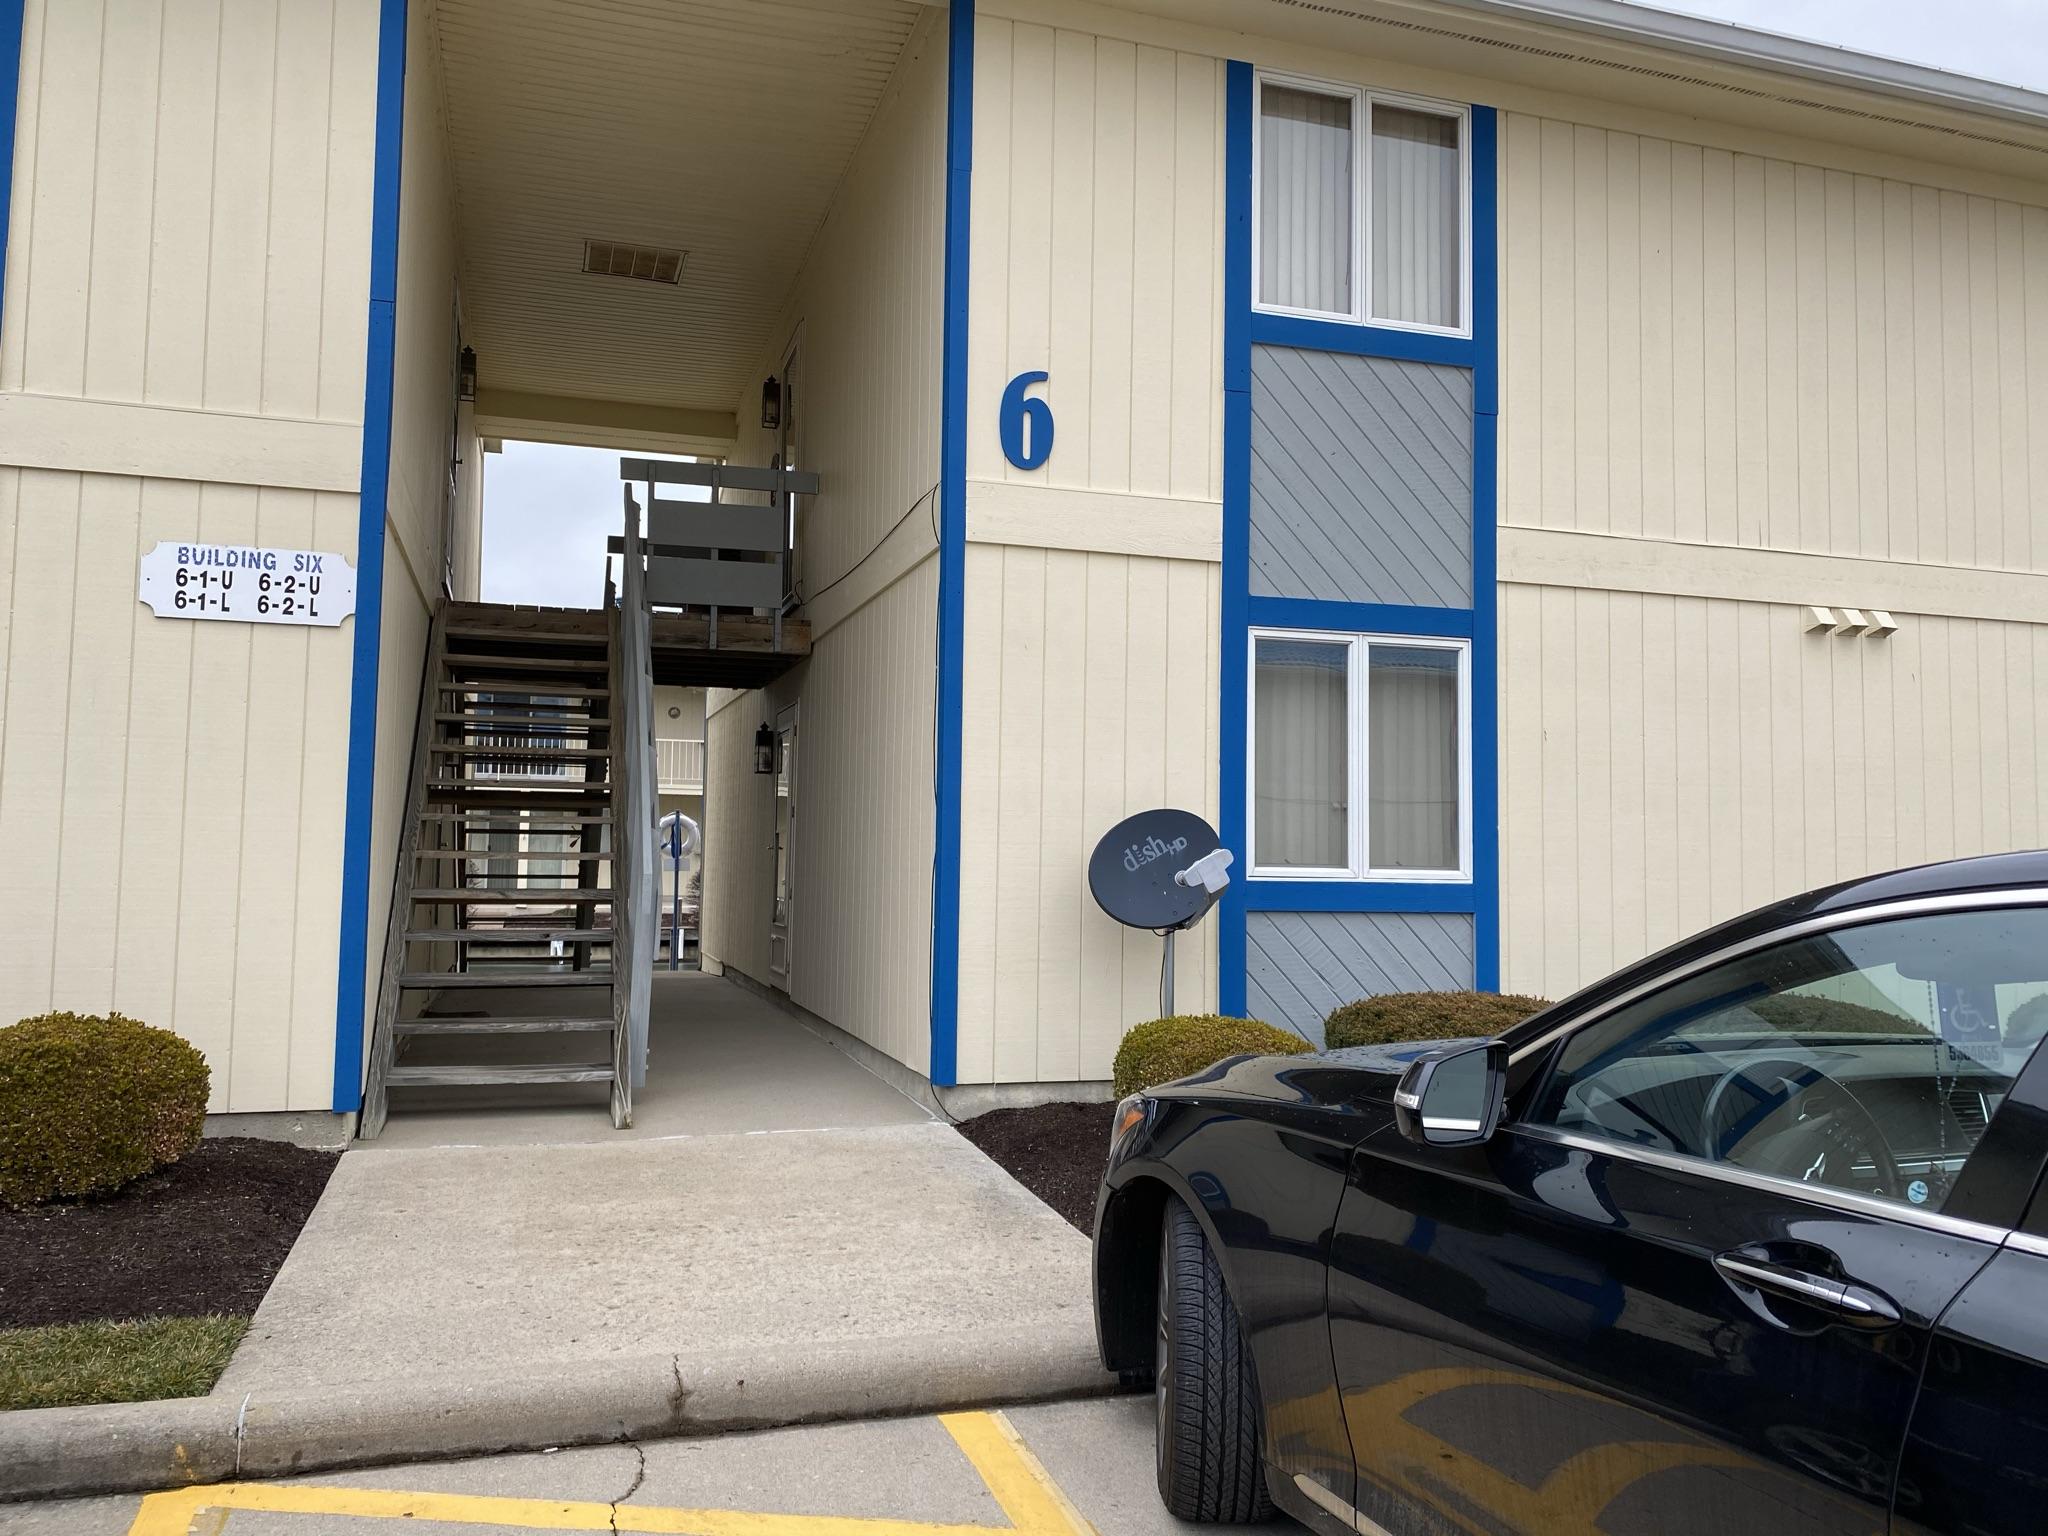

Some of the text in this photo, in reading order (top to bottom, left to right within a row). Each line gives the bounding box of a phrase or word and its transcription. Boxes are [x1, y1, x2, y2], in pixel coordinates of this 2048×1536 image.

[999, 370, 1055, 471] 6
[177, 546, 323, 574] BUILDING SIX
[175, 567, 321, 596] 6-1-U 6-2-U
[174, 589, 319, 617] 6-1-L 6-2-L
